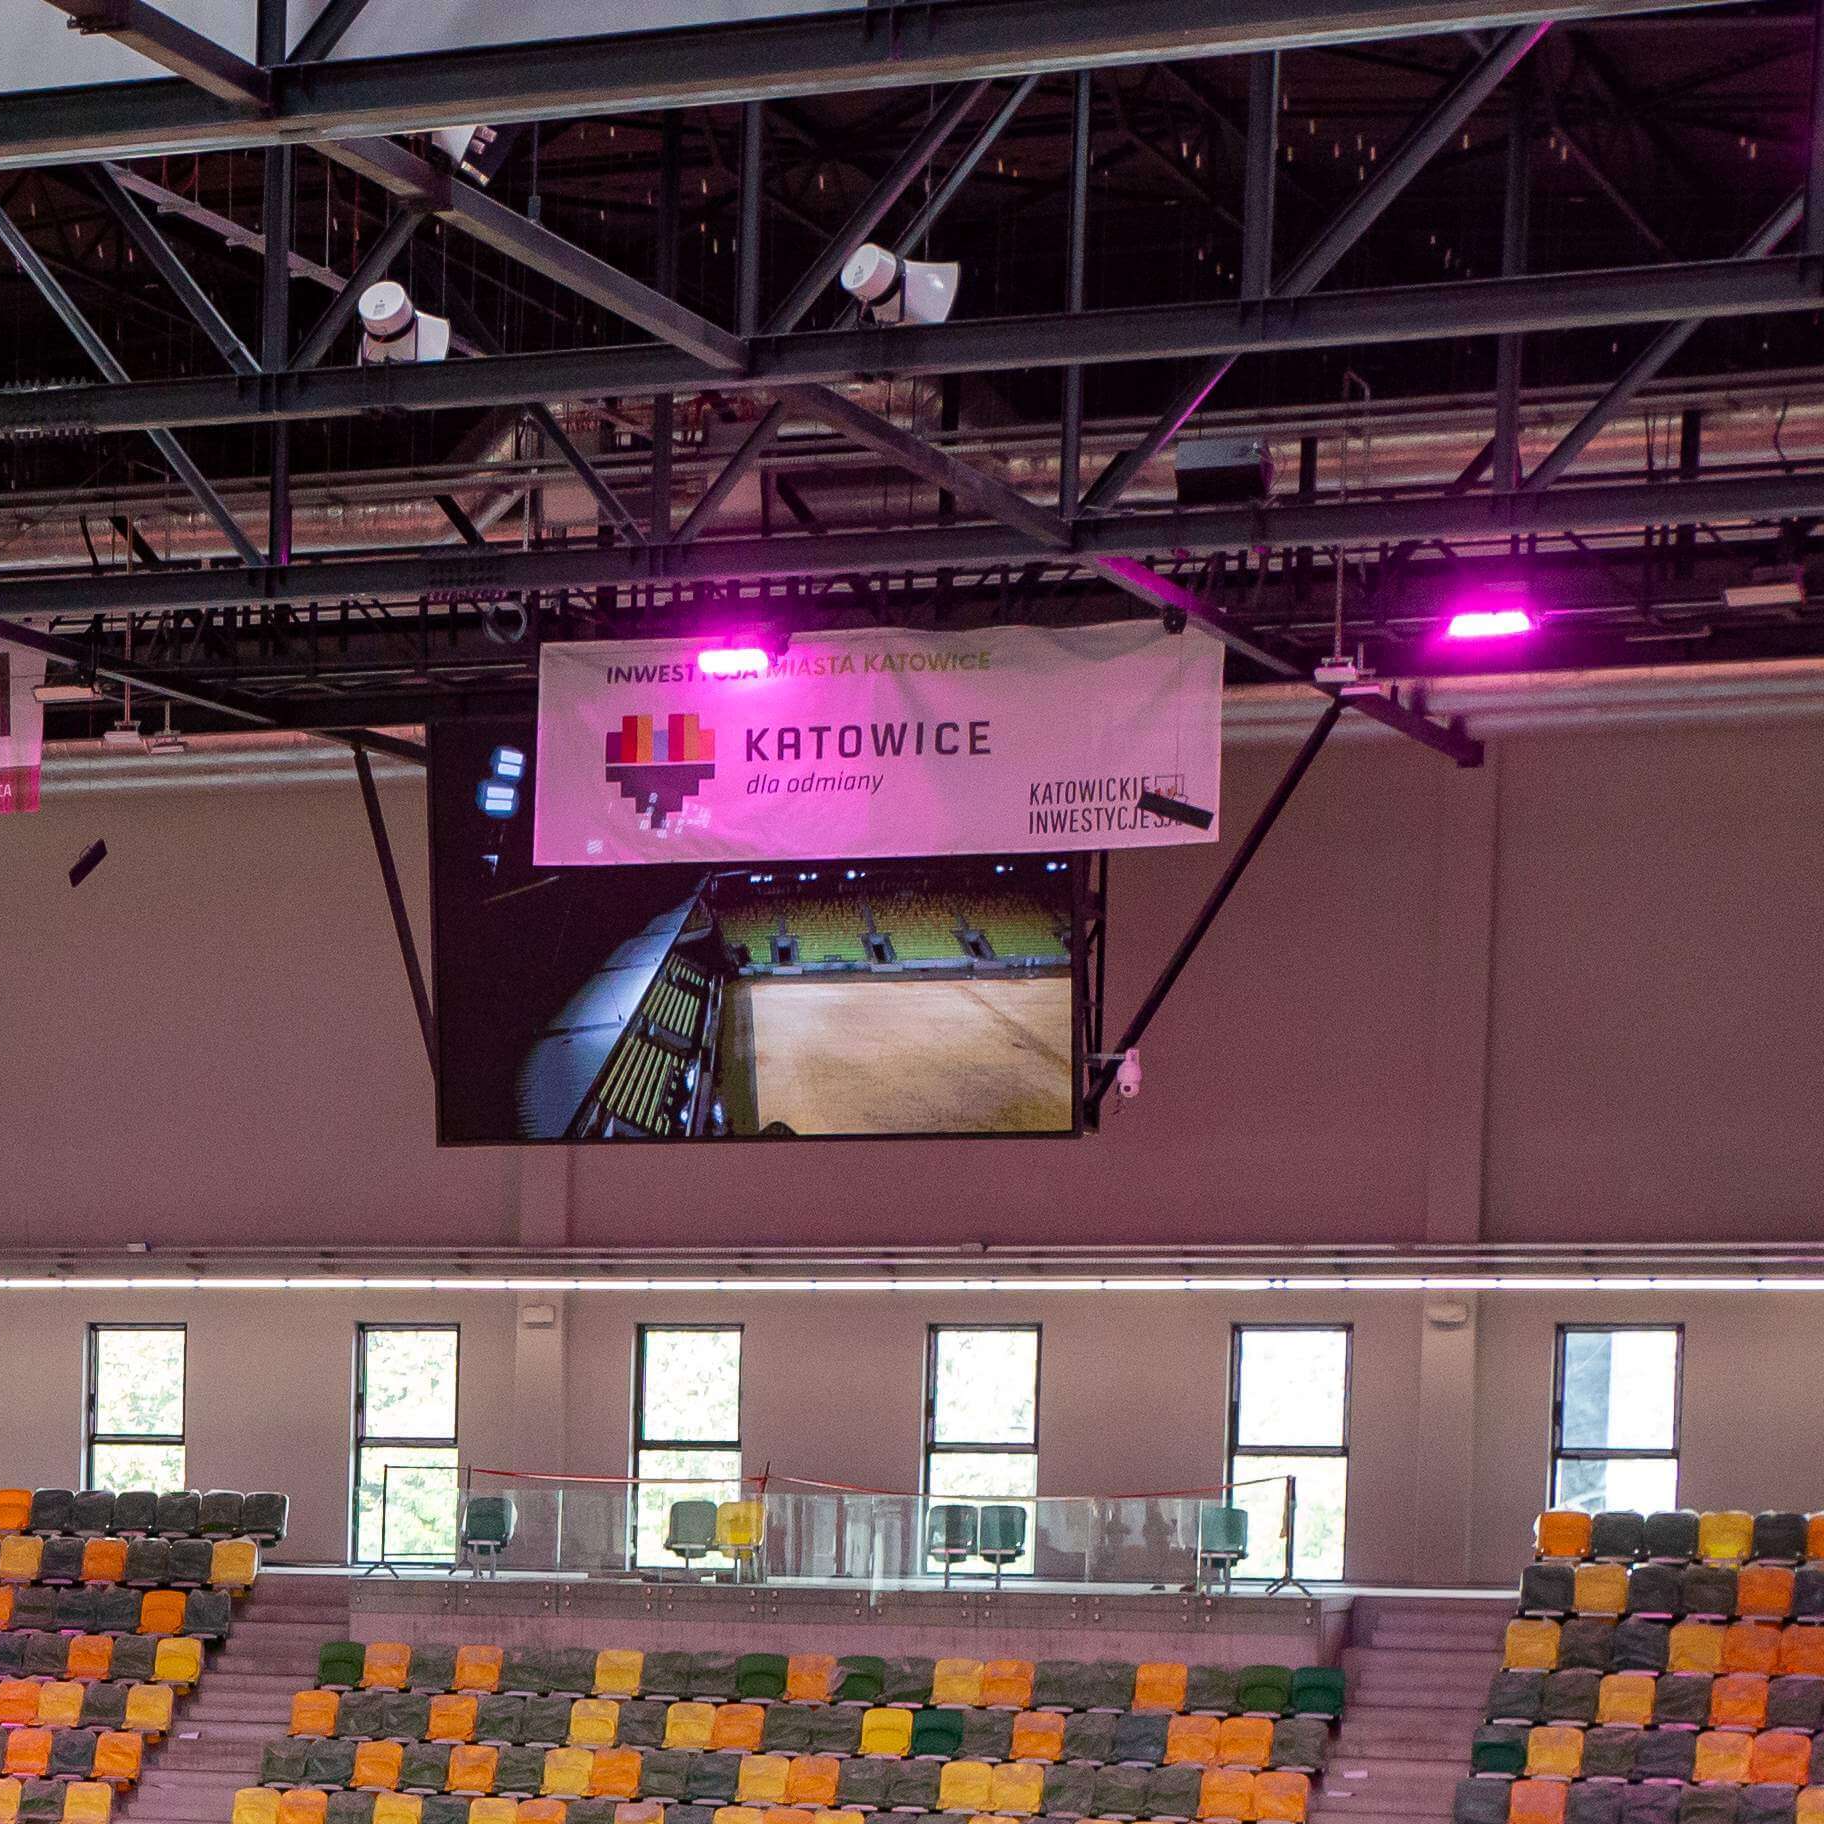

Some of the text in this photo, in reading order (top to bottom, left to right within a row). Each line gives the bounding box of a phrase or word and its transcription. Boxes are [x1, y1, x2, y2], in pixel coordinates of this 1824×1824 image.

[863, 651, 991, 674] KATOWICE
[746, 720, 991, 762] KATOWICE
[746, 771, 884, 795] dla odmiany
[1029, 776, 1150, 806] KATOWICKIE
[1028, 806, 1150, 834] INWESTYCJE
